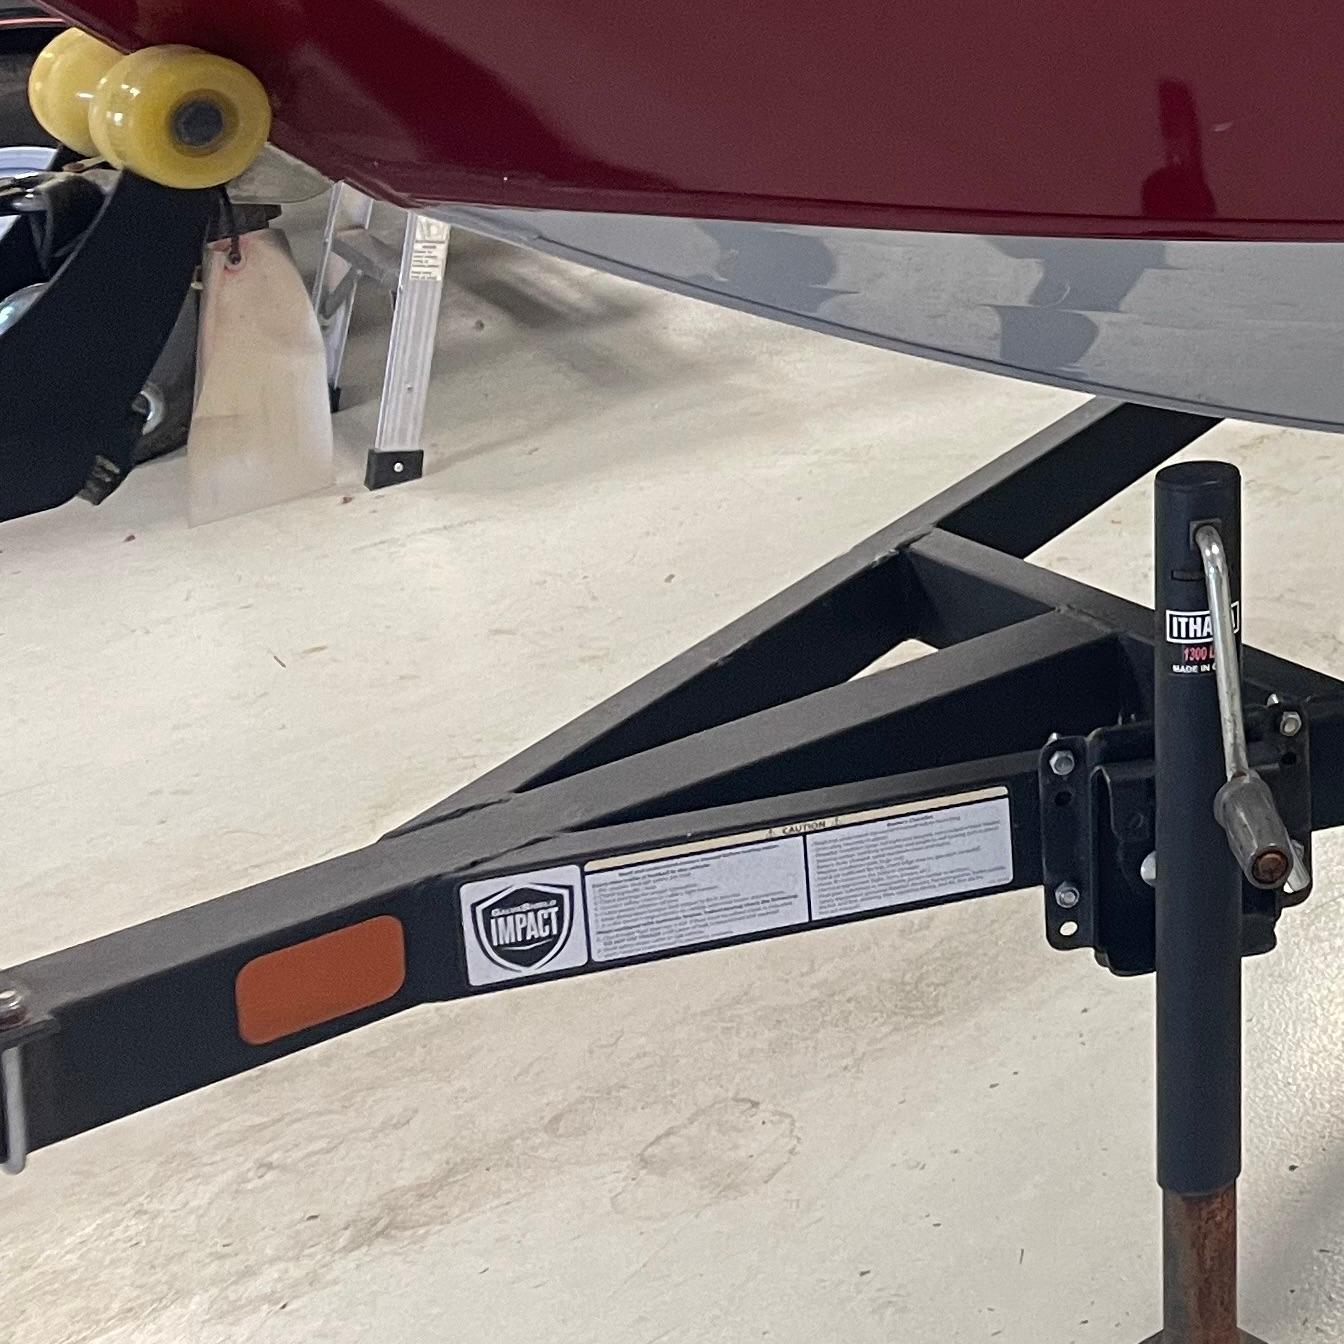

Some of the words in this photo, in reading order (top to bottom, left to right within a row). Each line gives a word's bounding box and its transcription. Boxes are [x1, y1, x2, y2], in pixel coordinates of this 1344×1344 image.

[1184, 646, 1208, 661] 1300
[1172, 664, 1198, 673] MADE
[1200, 663, 1211, 672] IN
[782, 820, 827, 836] CAUTION
[490, 906, 559, 947] IMPACT
